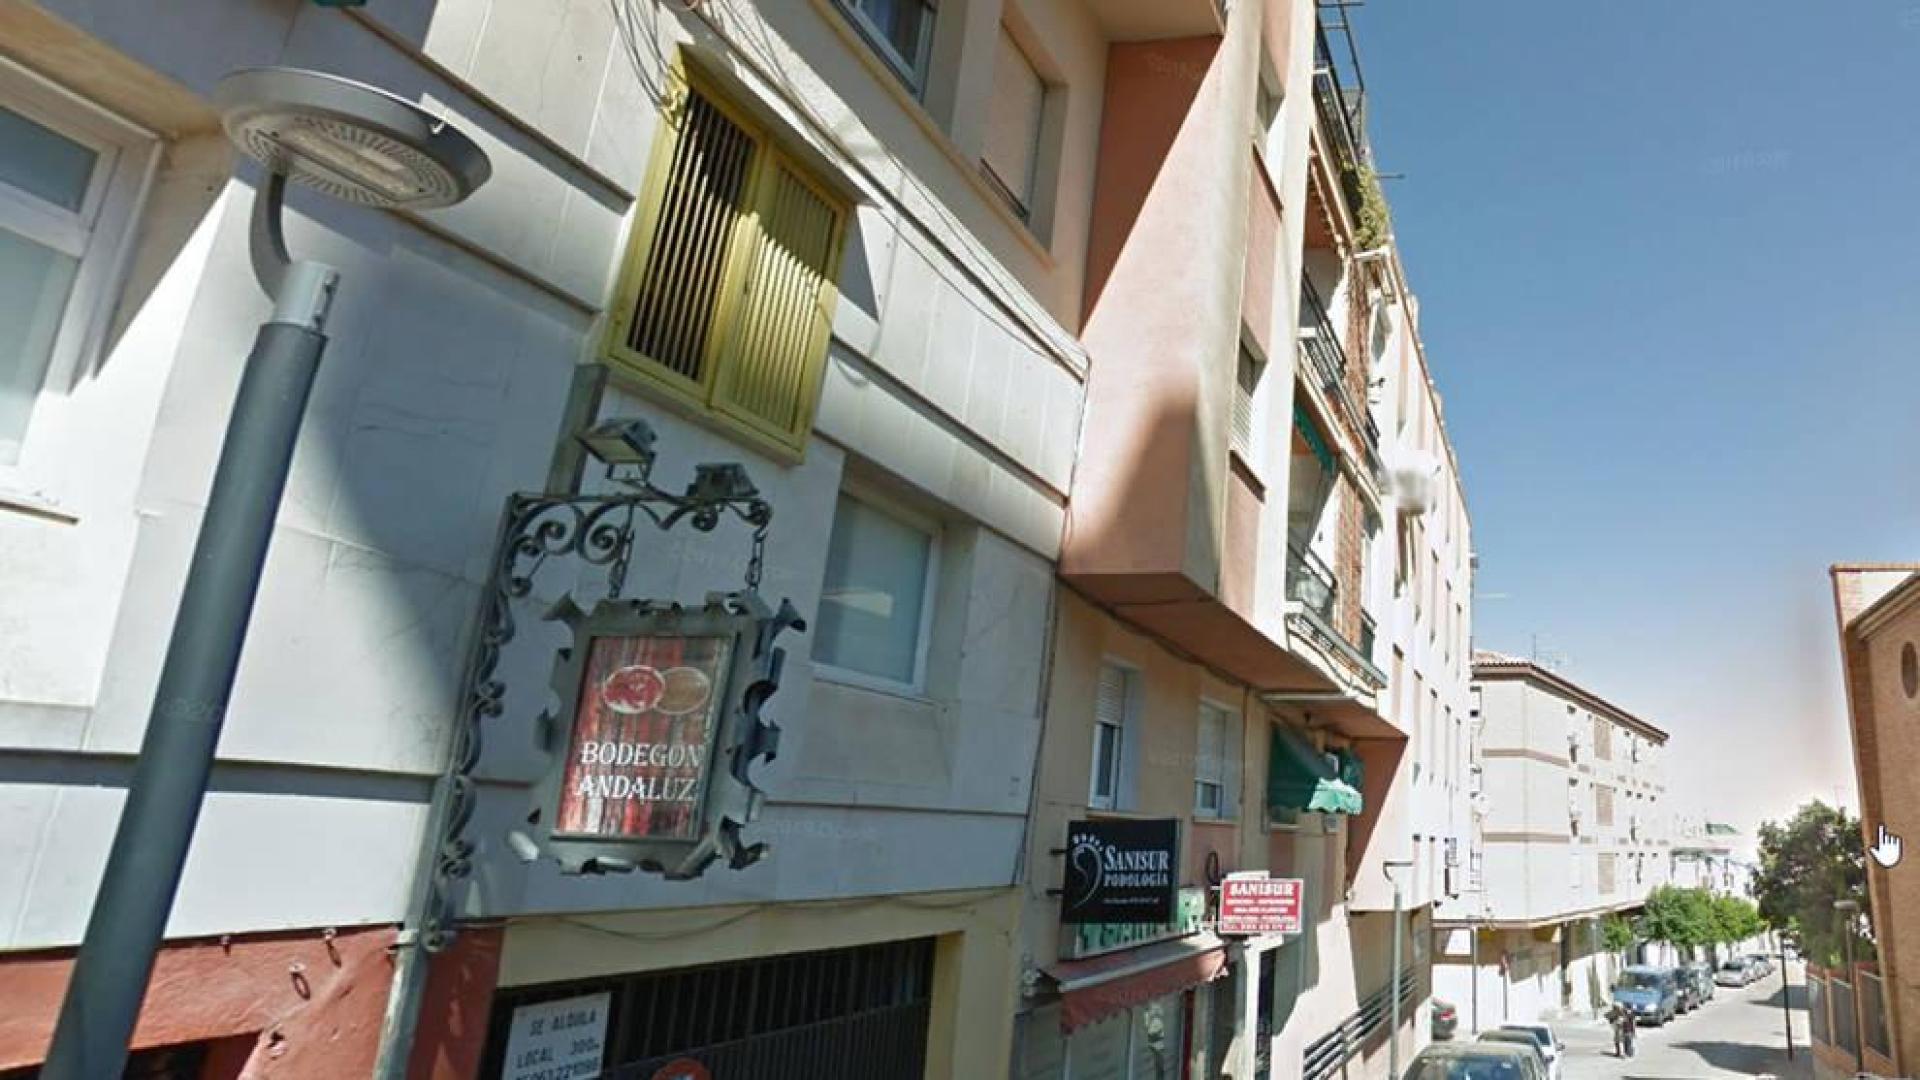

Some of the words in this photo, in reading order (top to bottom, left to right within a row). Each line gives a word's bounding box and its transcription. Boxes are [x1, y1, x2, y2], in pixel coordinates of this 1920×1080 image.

[575, 775, 698, 802] ANDALUZ
[1104, 845, 1169, 871] SANISUR
[1229, 883, 1294, 897] SANISUR
[529, 1018, 544, 1036] SE
[551, 1009, 597, 1031] ALQUILA
[515, 1047, 554, 1069] LOCAL
